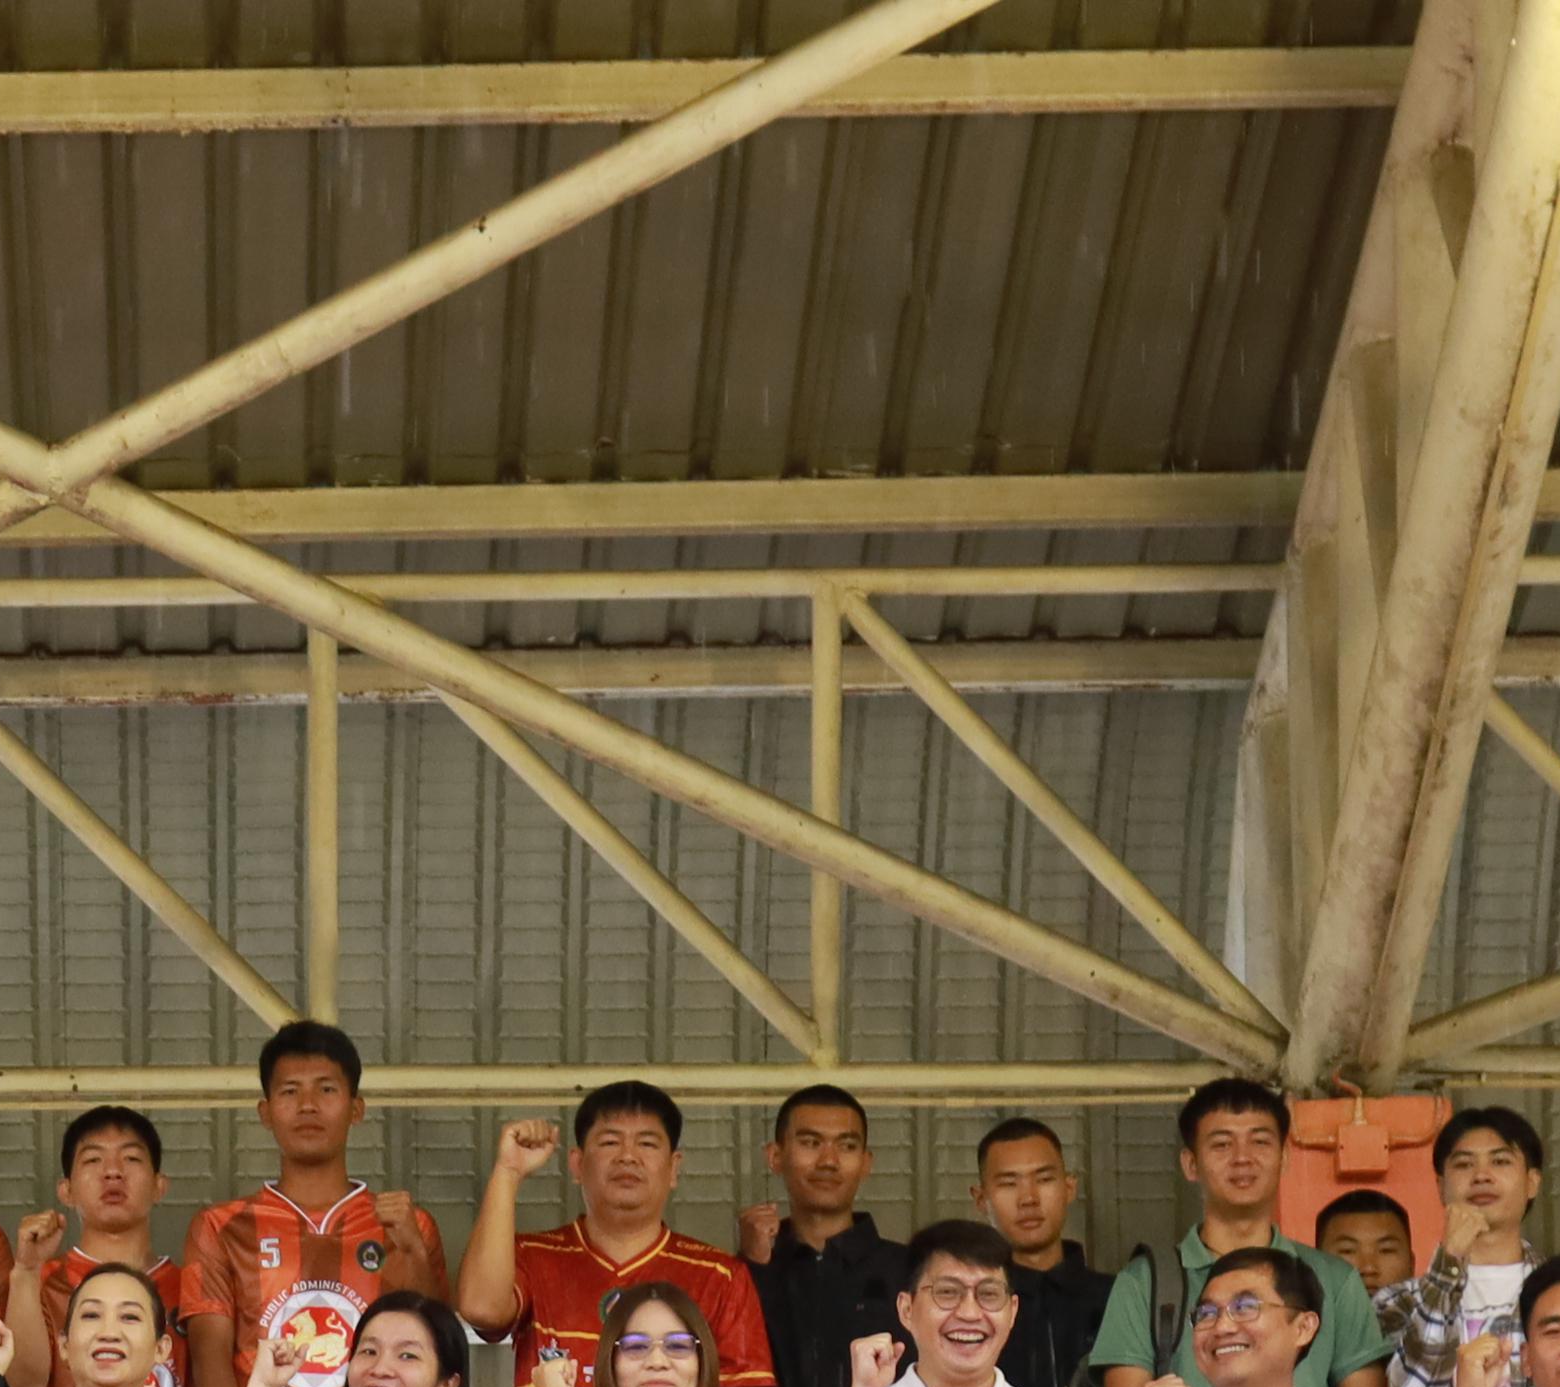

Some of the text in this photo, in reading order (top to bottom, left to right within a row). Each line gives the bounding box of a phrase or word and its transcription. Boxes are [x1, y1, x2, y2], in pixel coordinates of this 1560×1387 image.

[260, 1237, 280, 1268] 5
[259, 1279, 368, 1328] PUBLIC ADMINISTRAT
